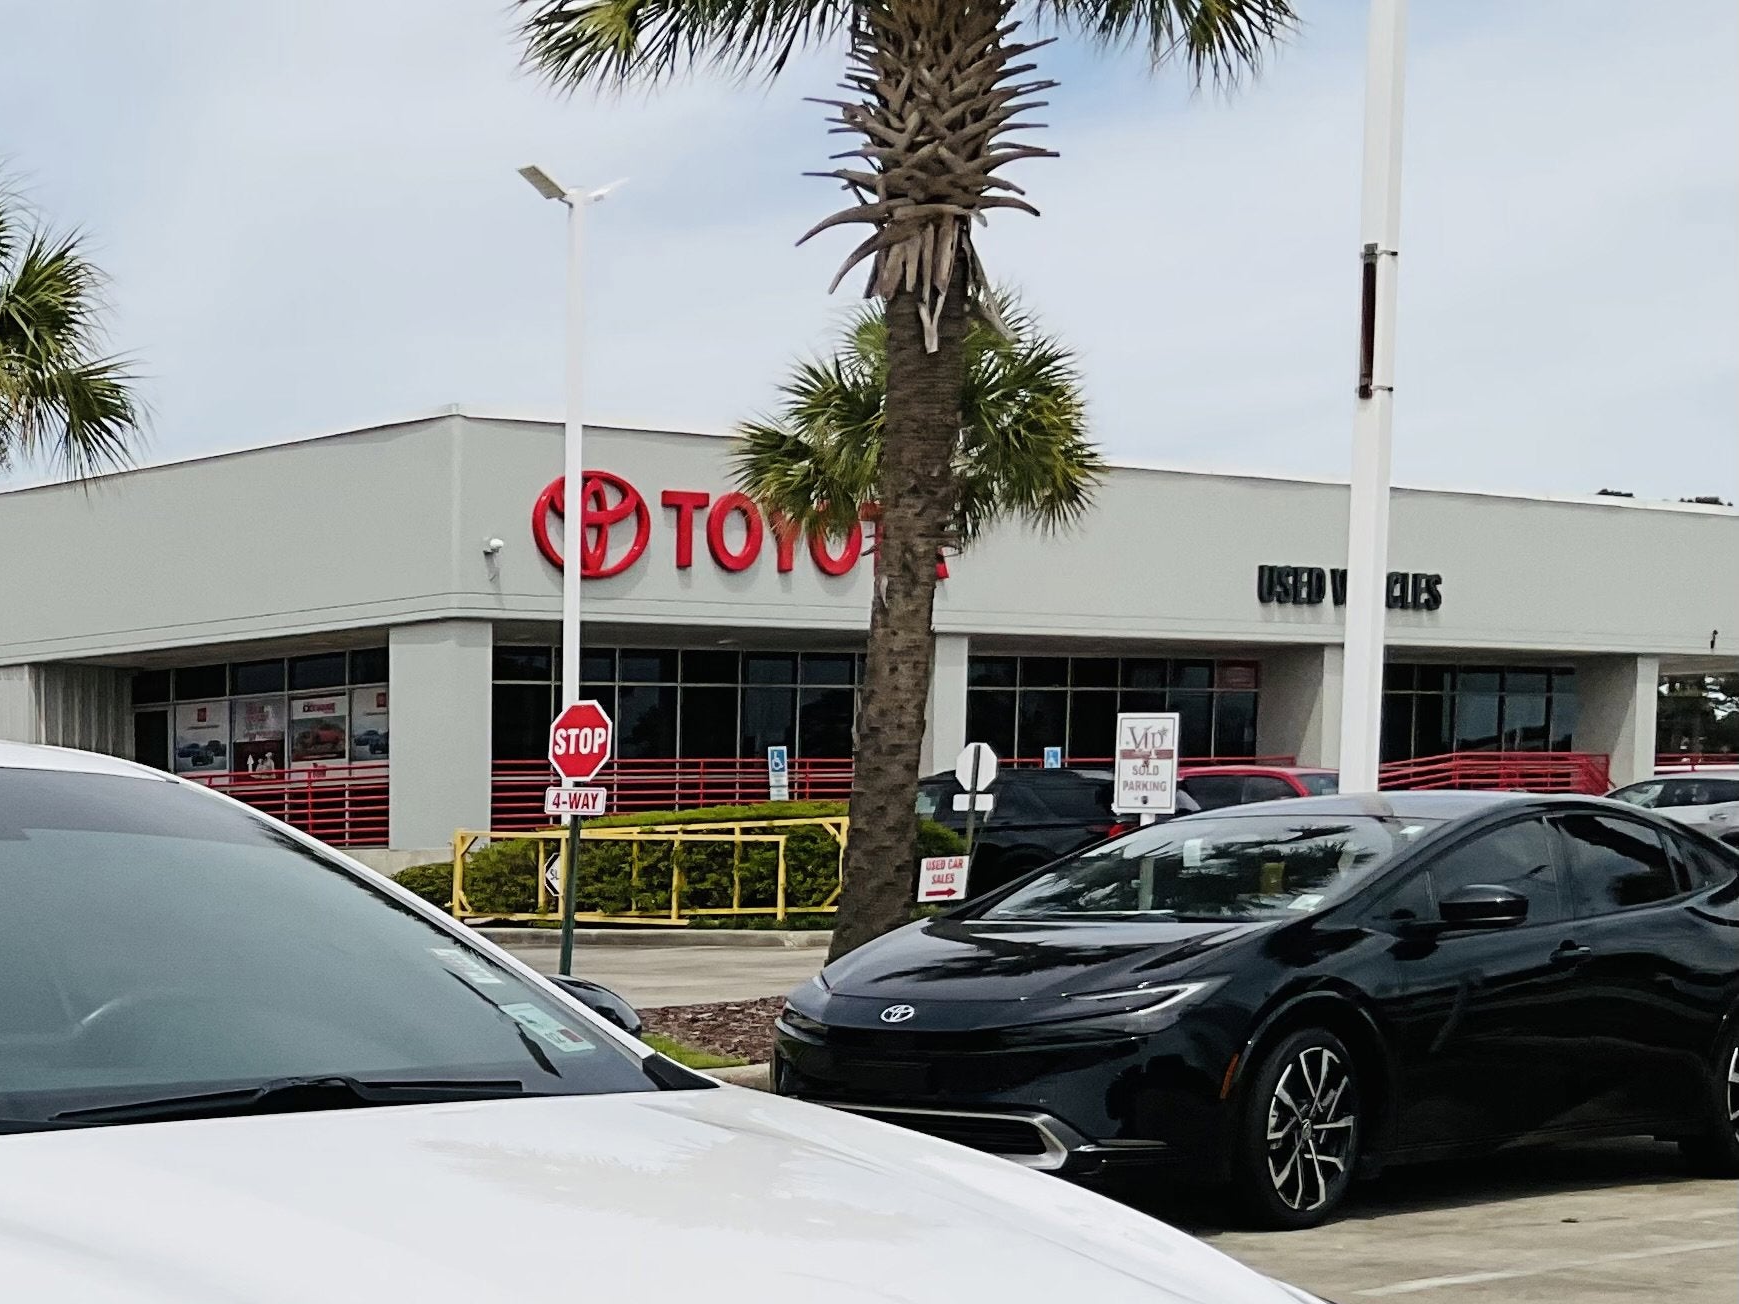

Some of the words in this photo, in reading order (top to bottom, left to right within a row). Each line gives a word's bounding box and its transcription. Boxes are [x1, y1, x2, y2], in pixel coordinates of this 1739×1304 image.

[661, 490, 950, 580] TOYO
[1257, 564, 1327, 605] USED
[1329, 567, 1443, 611] VCLES
[553, 727, 607, 756] STOP
[1132, 764, 1160, 776] SOLD
[1122, 780, 1168, 792] PARKING
[551, 791, 600, 810] 4-WAY
[925, 858, 946, 871] USED
[948, 857, 965, 869] CAR
[931, 873, 955, 884] SALES
